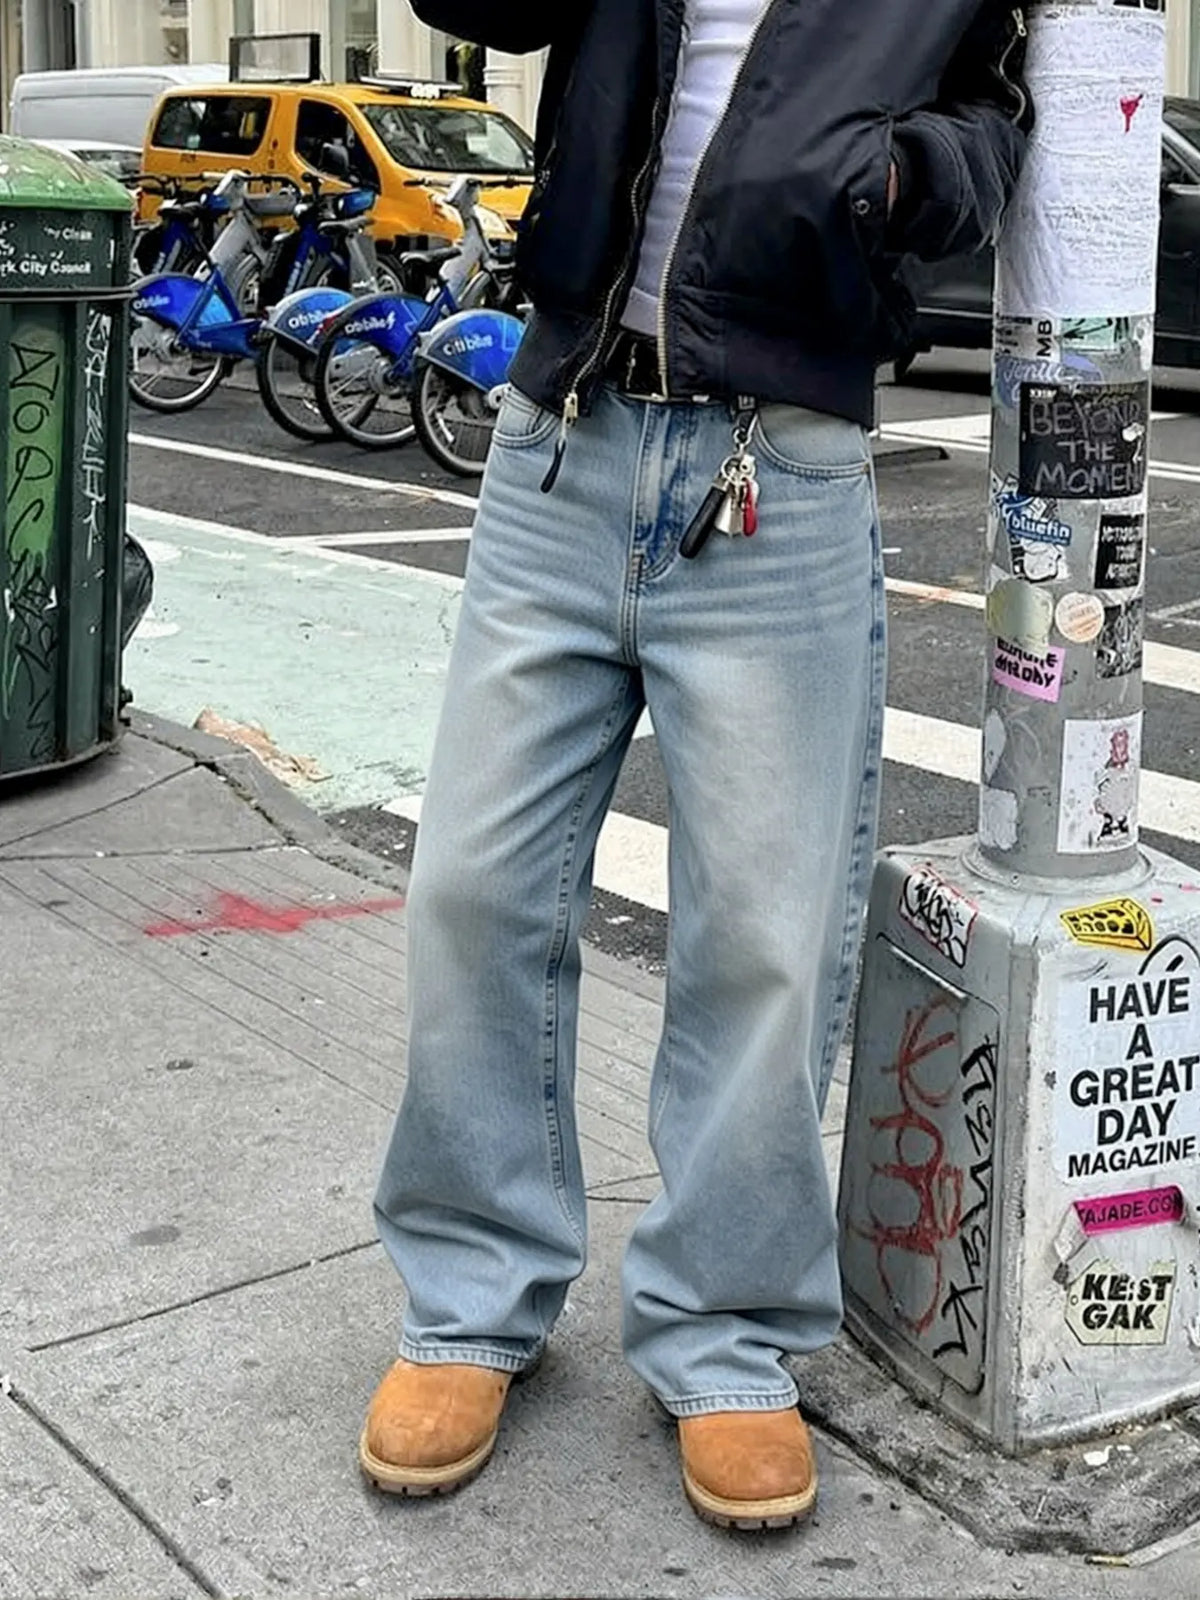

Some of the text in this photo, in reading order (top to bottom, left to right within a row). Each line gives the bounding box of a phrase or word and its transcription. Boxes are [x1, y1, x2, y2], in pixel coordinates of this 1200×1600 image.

[20, 261, 48, 276] City
[50, 261, 91, 273] Council
[1029, 400, 1142, 438] BEYOND
[1057, 439, 1115, 463] THE
[1012, 512, 1070, 538] bluefin
[1089, 976, 1190, 1023] HAVE
[1125, 1023, 1153, 1060] A
[1070, 1055, 1200, 1107] GREAT
[1097, 1099, 1177, 1146] DAY
[1082, 1302, 1157, 1331] GAK
